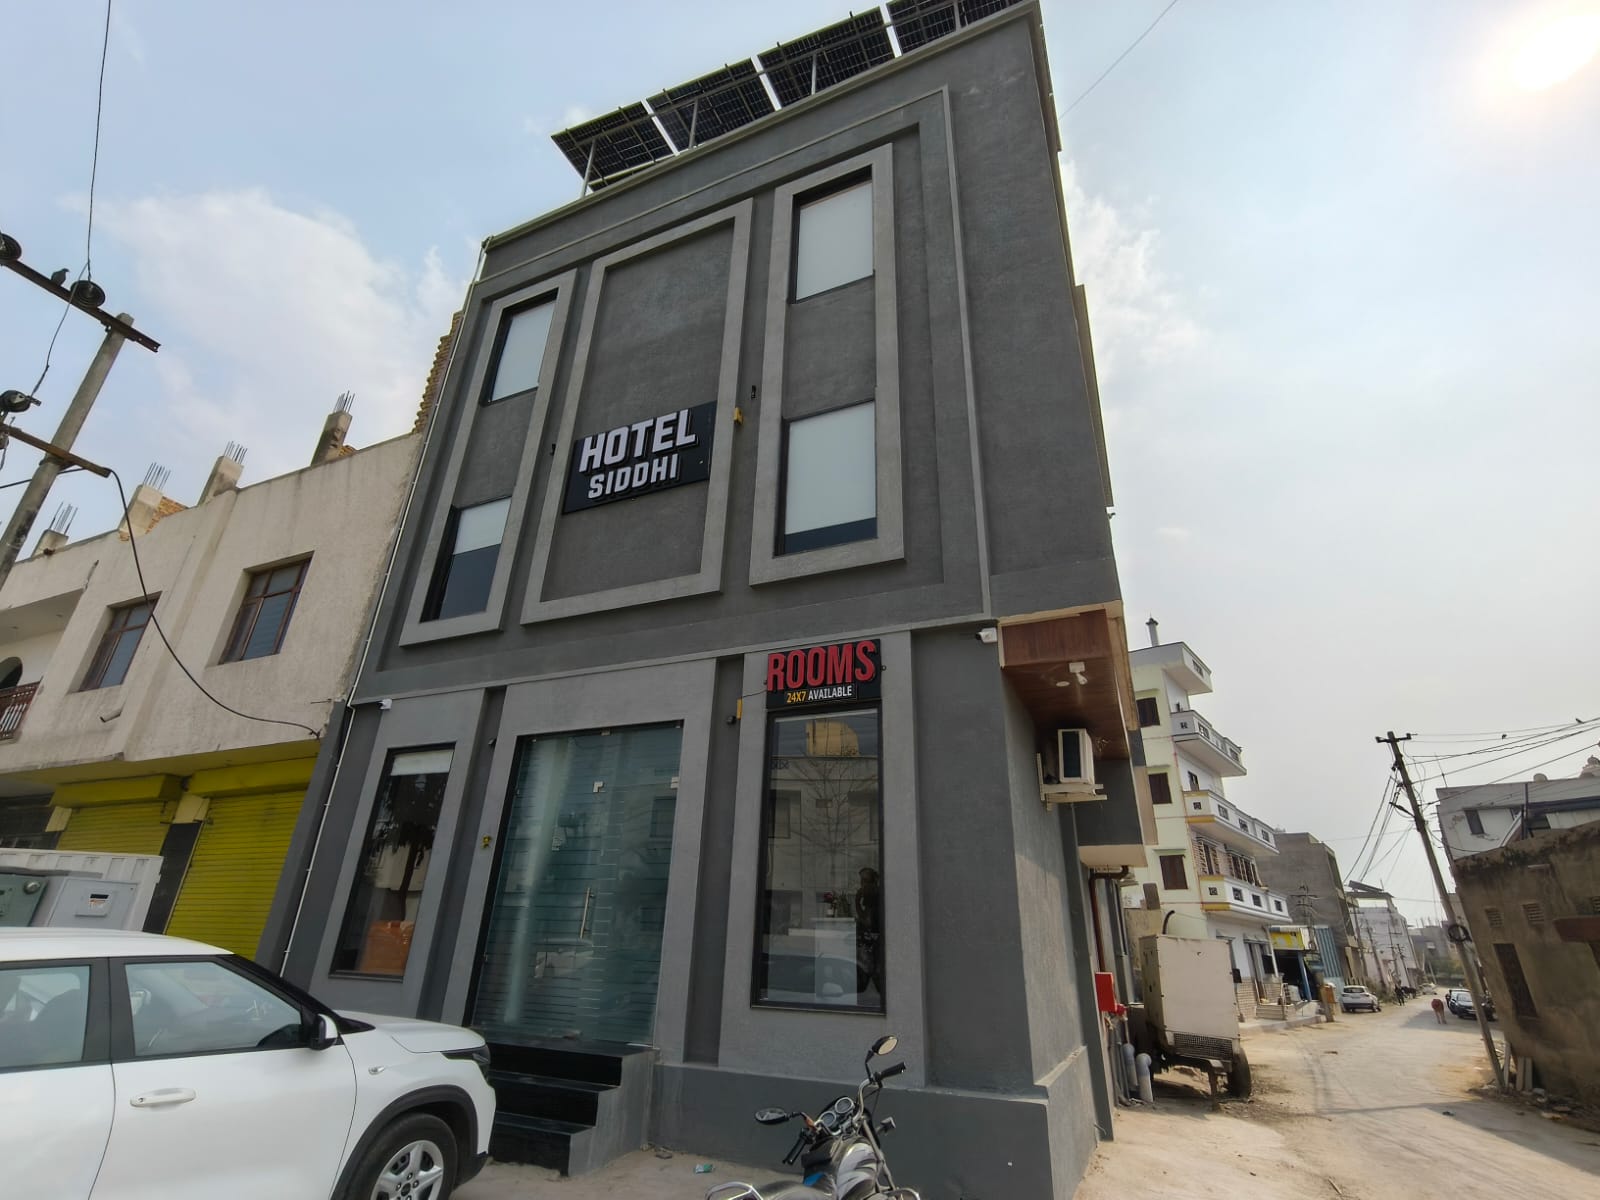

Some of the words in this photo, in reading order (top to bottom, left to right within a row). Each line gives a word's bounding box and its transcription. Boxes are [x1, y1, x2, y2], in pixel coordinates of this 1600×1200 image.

[578, 408, 697, 473] HOTEL
[588, 453, 679, 499] SIDDHI
[767, 639, 876, 691] ROOMS
[786, 690, 807, 703] 24X7
[808, 685, 853, 701] AVAILABLE
